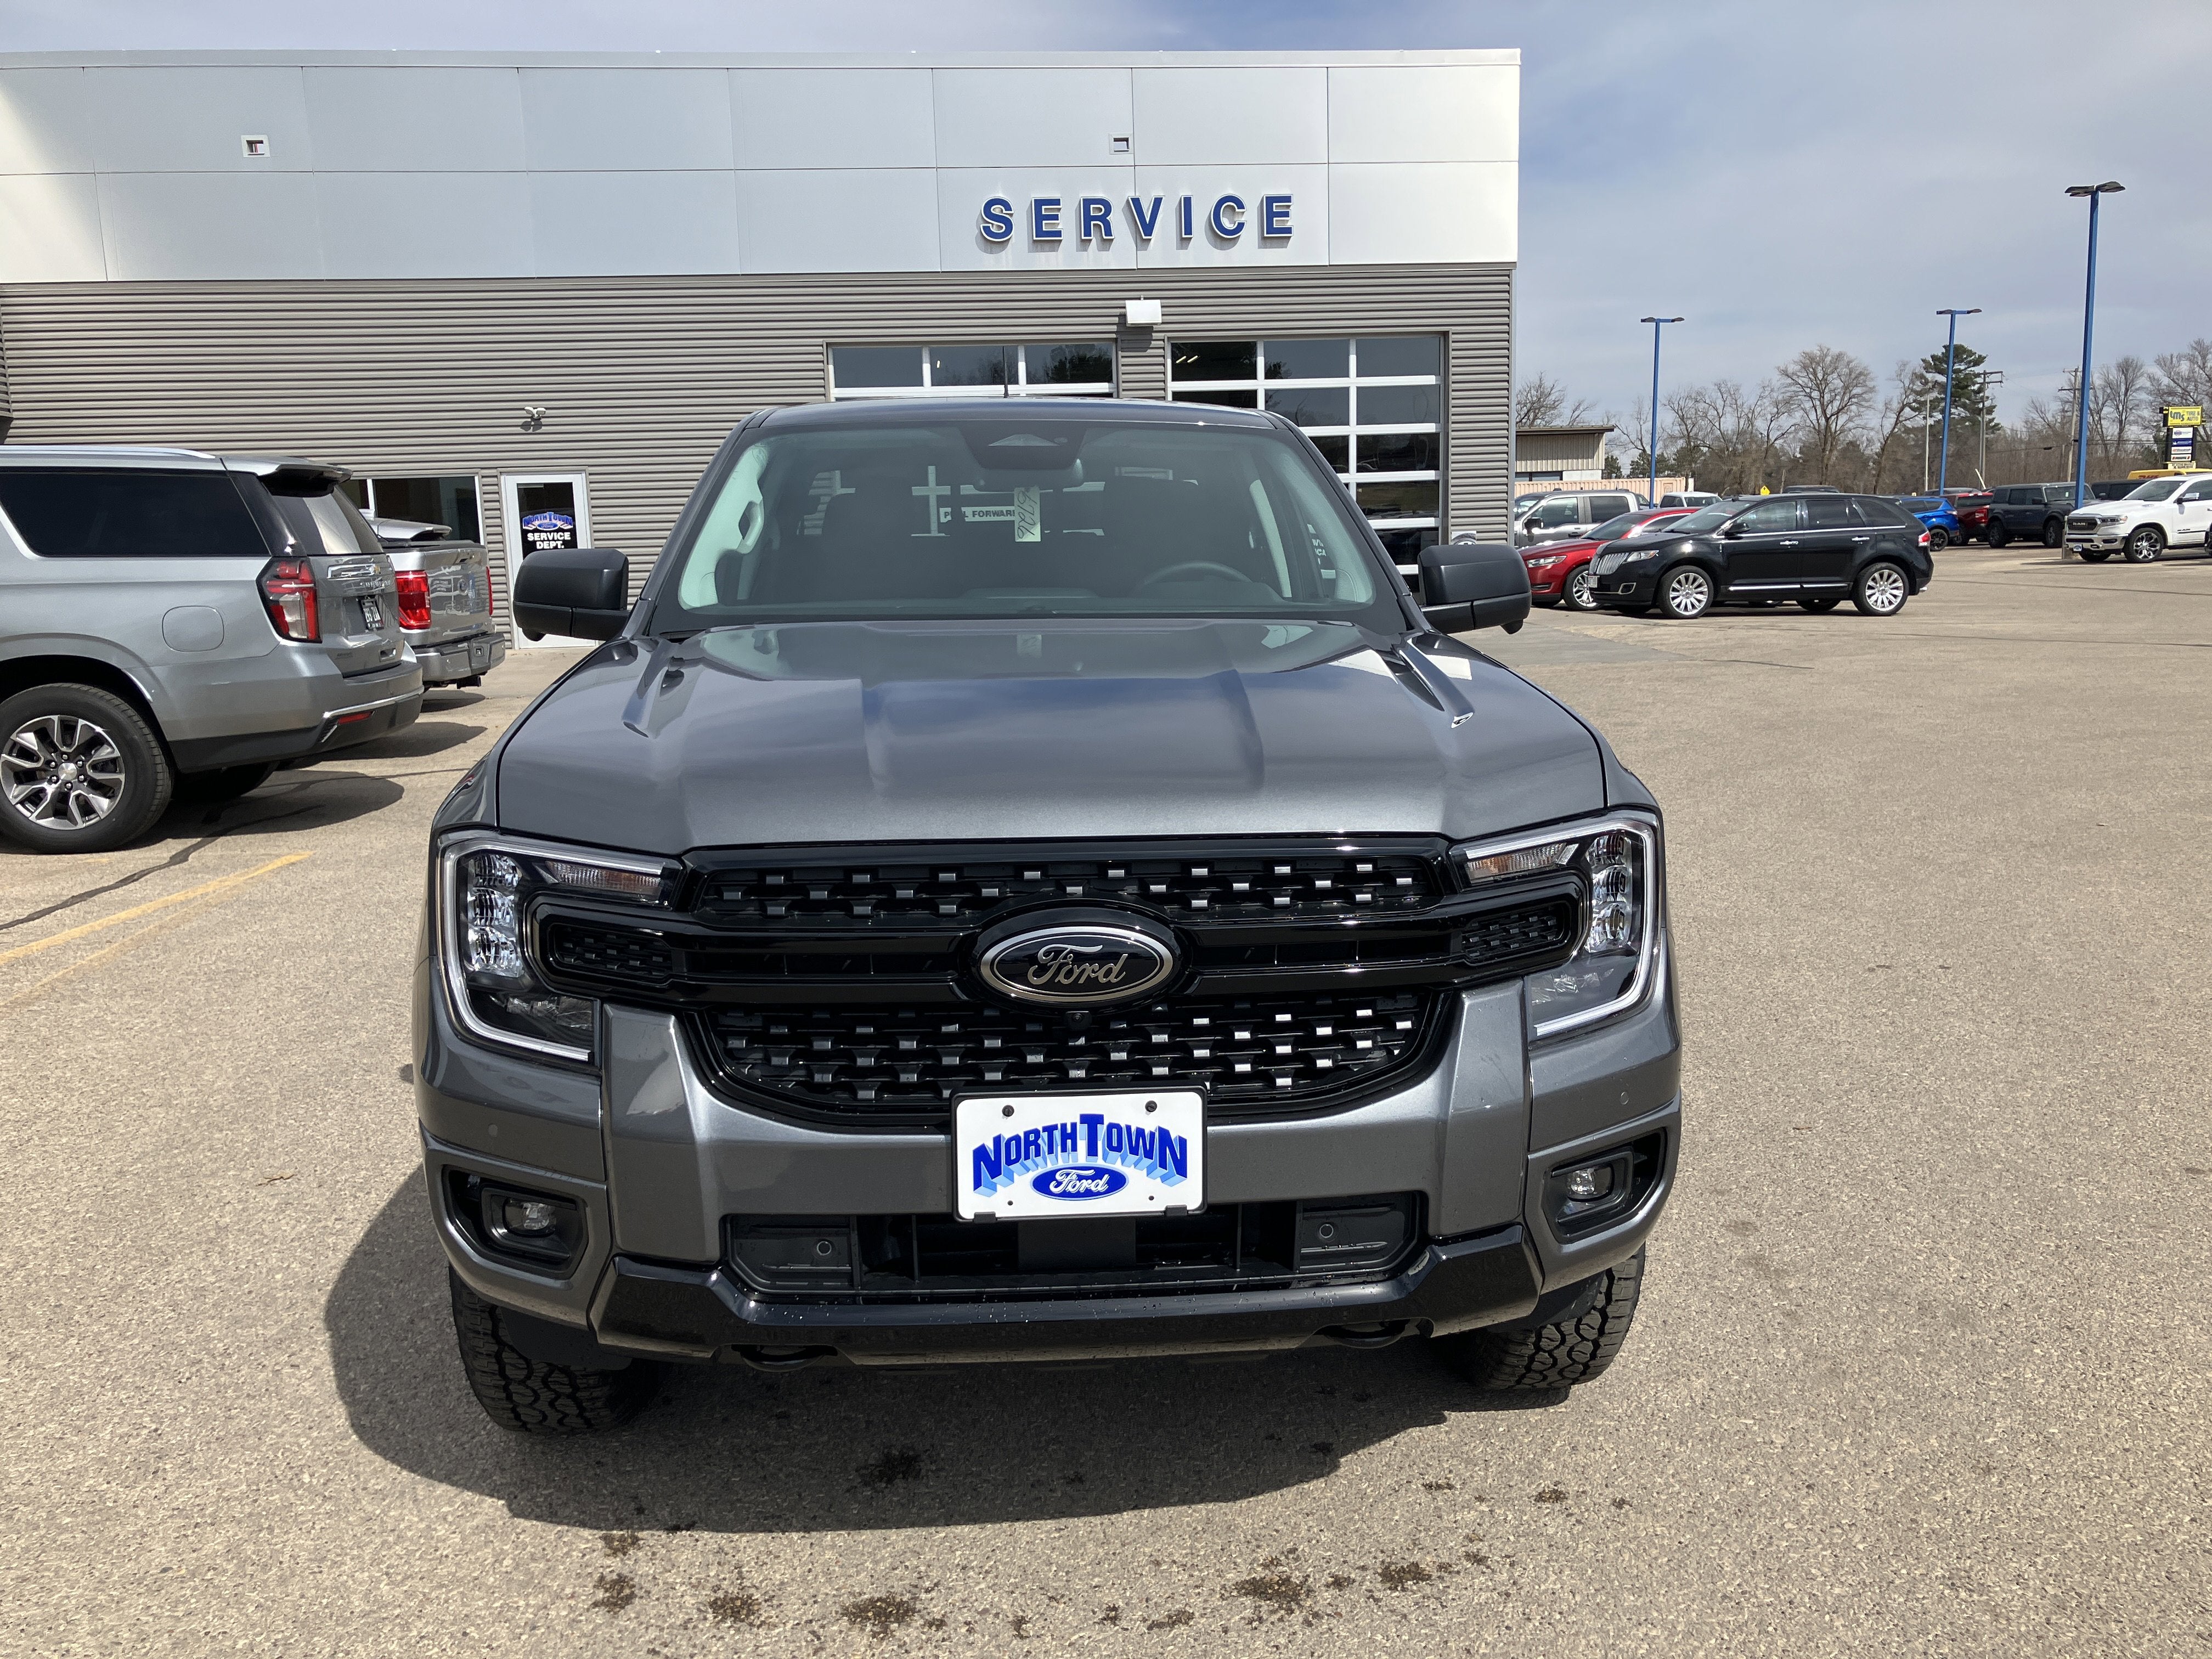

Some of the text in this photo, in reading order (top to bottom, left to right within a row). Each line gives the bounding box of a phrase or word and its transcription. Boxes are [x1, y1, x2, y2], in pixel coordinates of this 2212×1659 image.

[980, 194, 1294, 241] SERVICE
[1017, 490, 1036, 539] 6726
[527, 532, 571, 541] SERVICE
[536, 541, 565, 549] DEPT.
[1028, 944, 1128, 985] Ford
[1049, 1169, 1110, 1194] Ford
